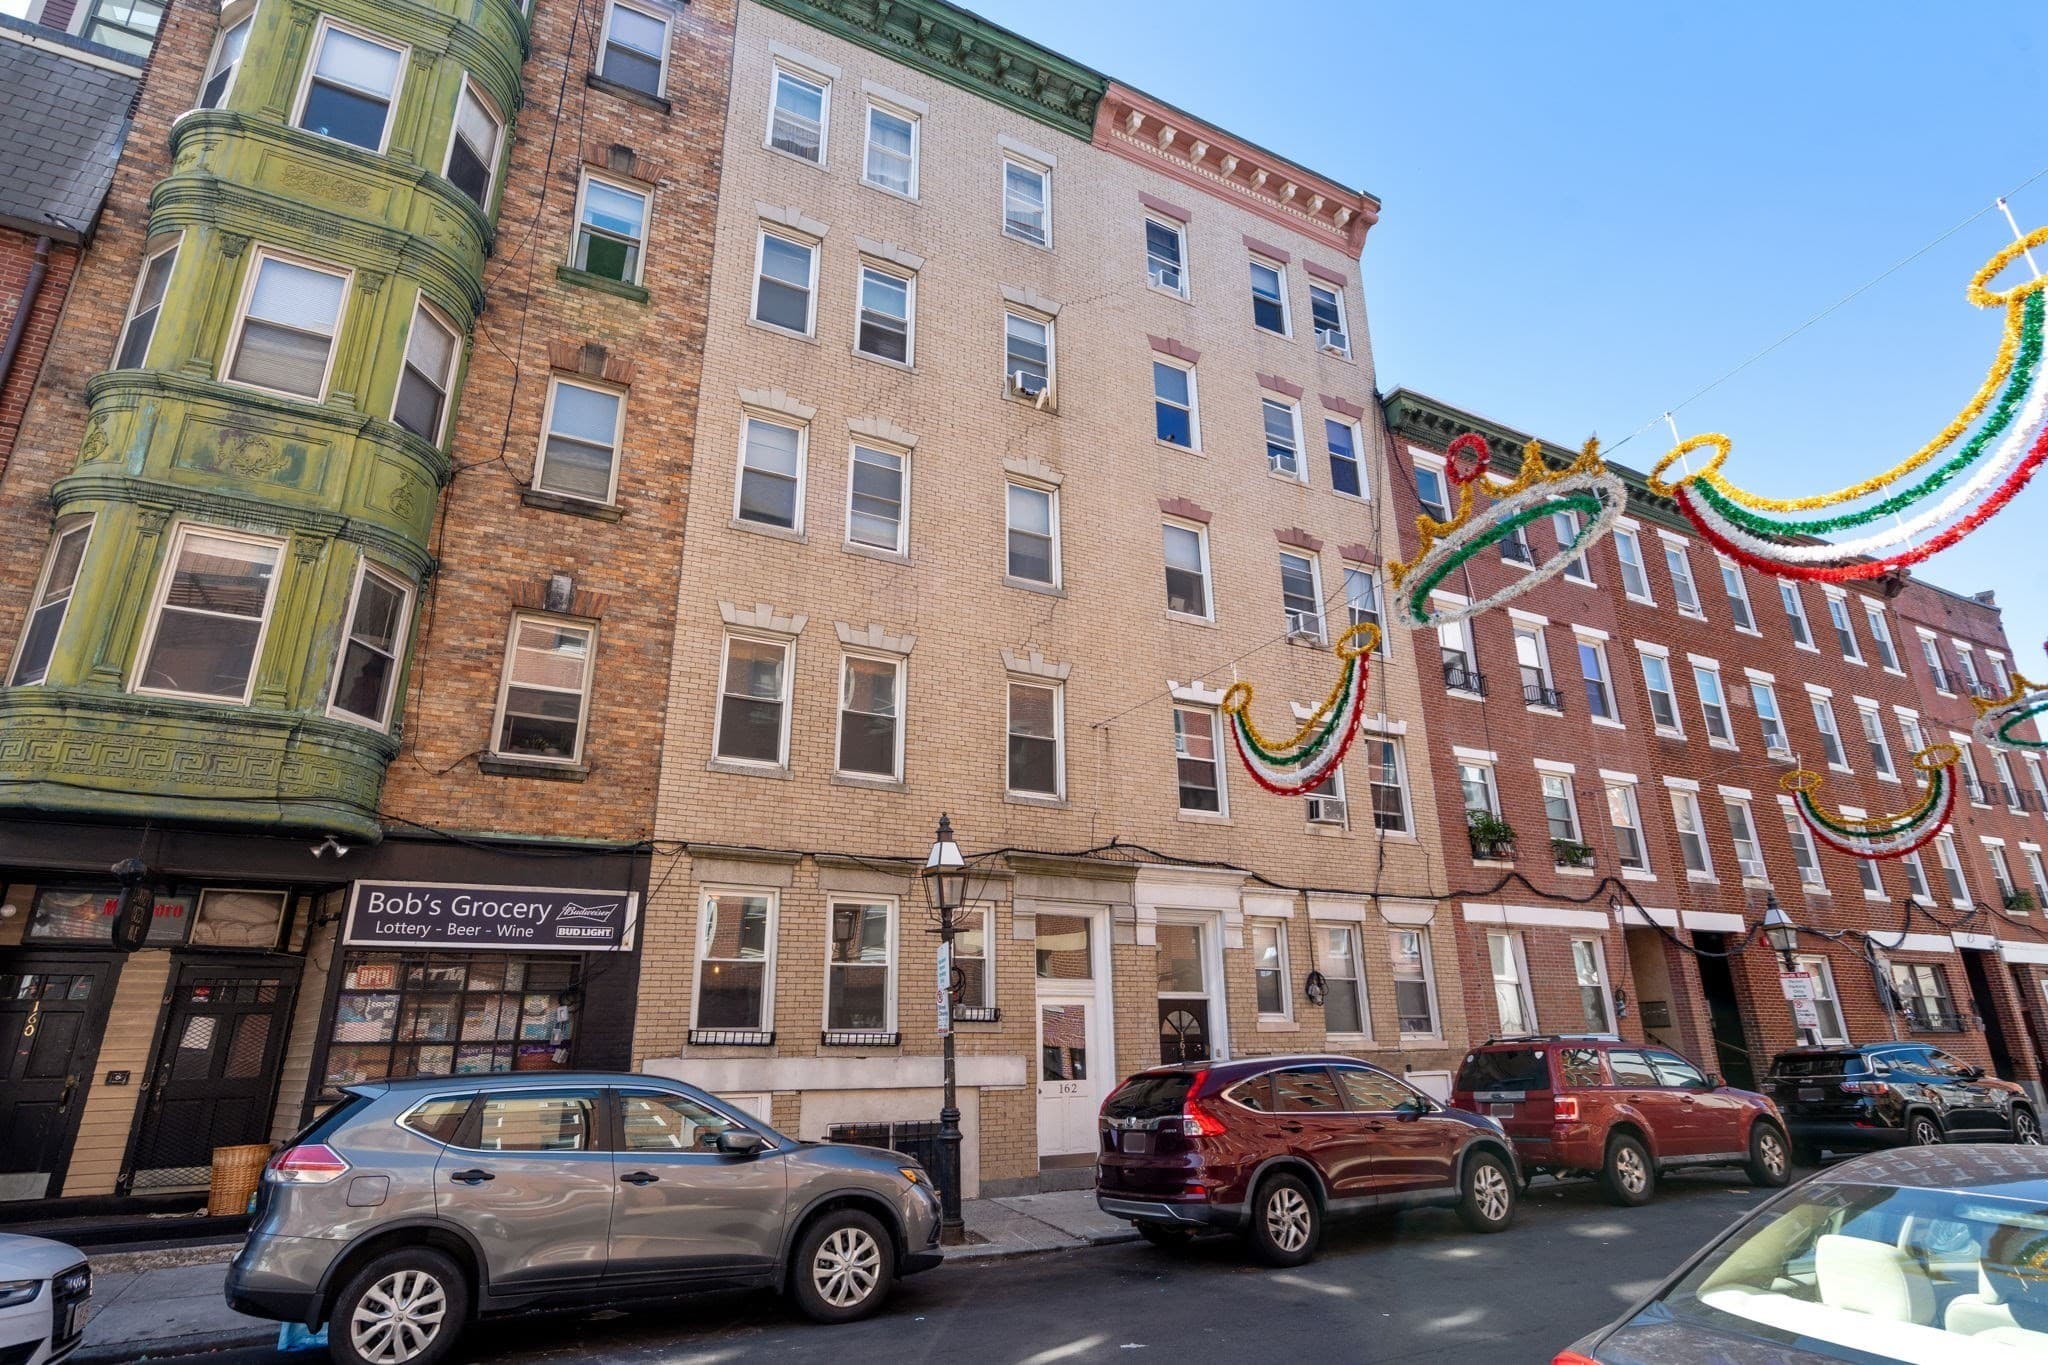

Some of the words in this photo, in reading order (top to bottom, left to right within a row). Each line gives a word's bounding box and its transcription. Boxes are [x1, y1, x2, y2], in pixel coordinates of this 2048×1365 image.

[368, 892, 442, 916] Bob's
[451, 896, 553, 925] Grocery
[563, 905, 612, 916] Budweiser
[375, 920, 432, 938] Lottery
[447, 923, 482, 936] Beer
[497, 924, 534, 938] Wine
[558, 927, 581, 936] BUD
[581, 928, 612, 937] LIGHT
[359, 968, 391, 986] OPEN
[409, 966, 466, 982] ATM
[24, 1000, 40, 1037] 160
[1059, 1083, 1078, 1094] 162
